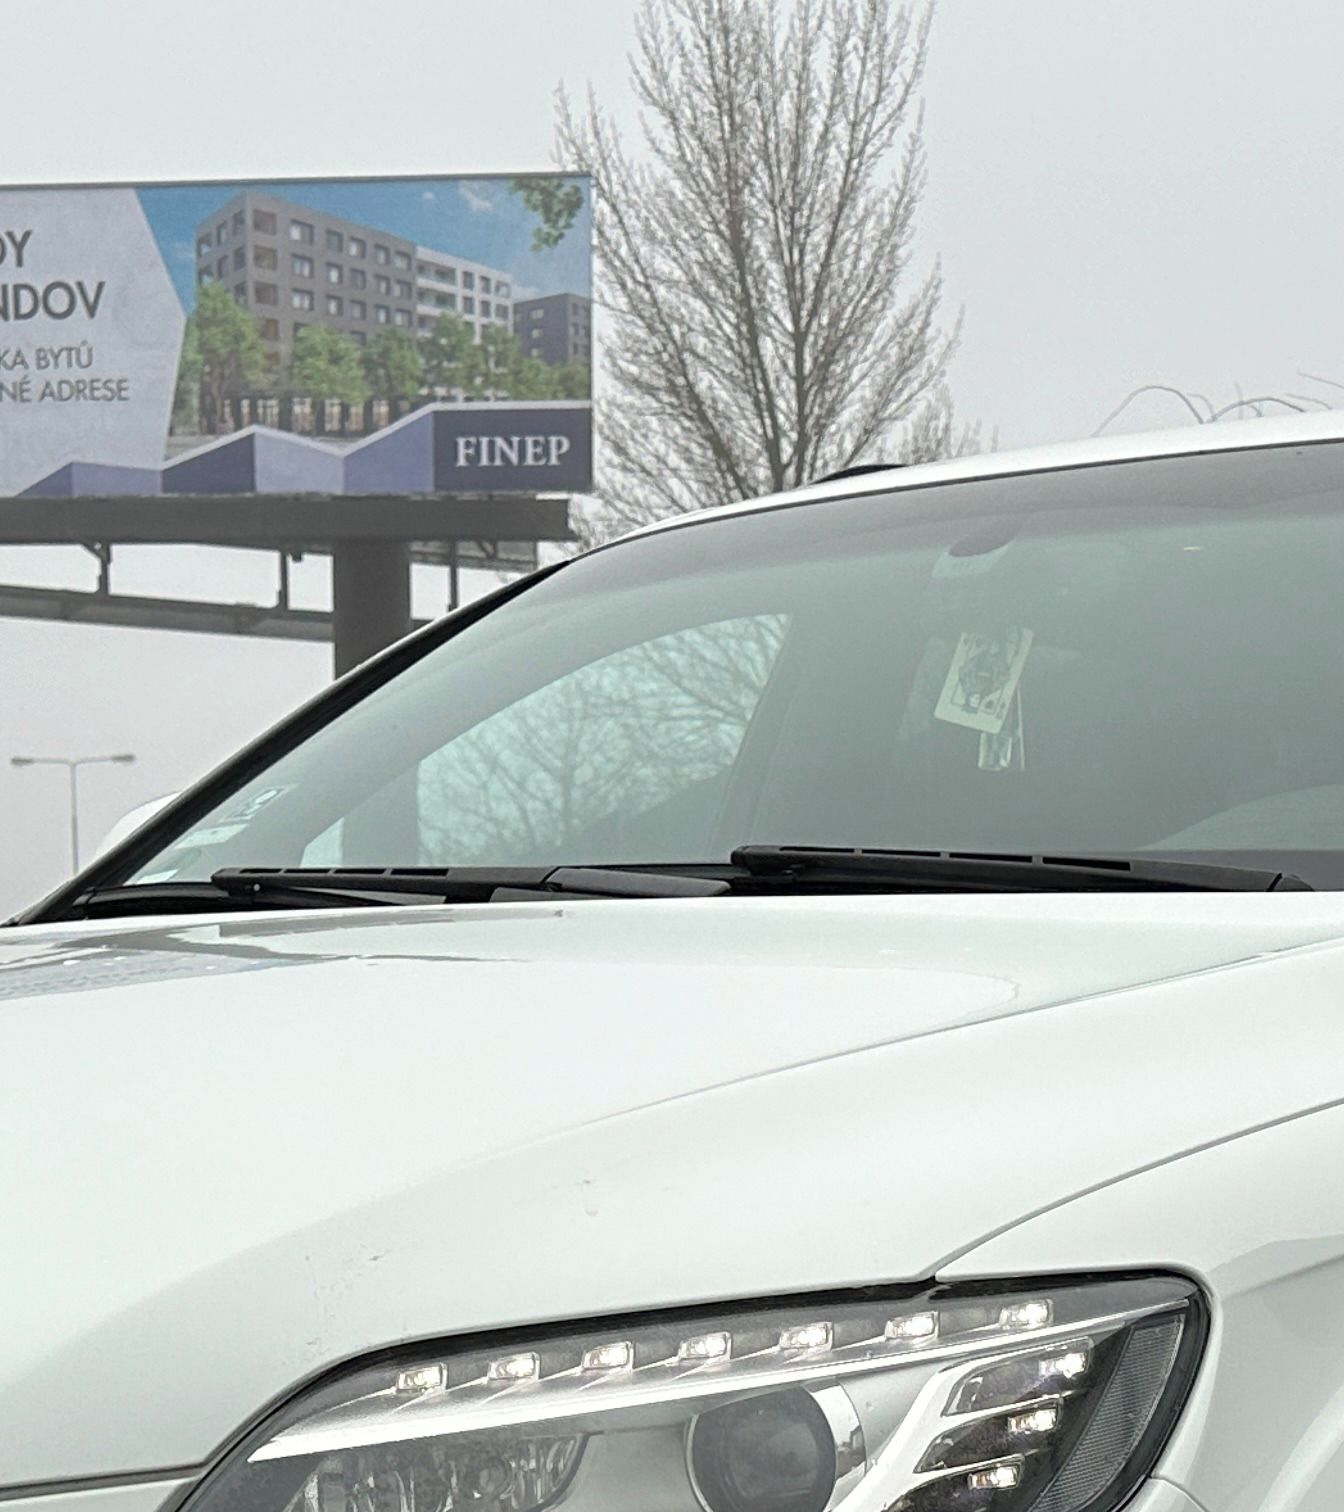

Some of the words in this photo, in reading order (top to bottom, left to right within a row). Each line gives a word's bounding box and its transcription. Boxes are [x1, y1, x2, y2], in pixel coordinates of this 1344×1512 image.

[35, 340, 94, 371] BYTŮ
[39, 378, 130, 402] ADRESE
[456, 435, 571, 467] FINEP
